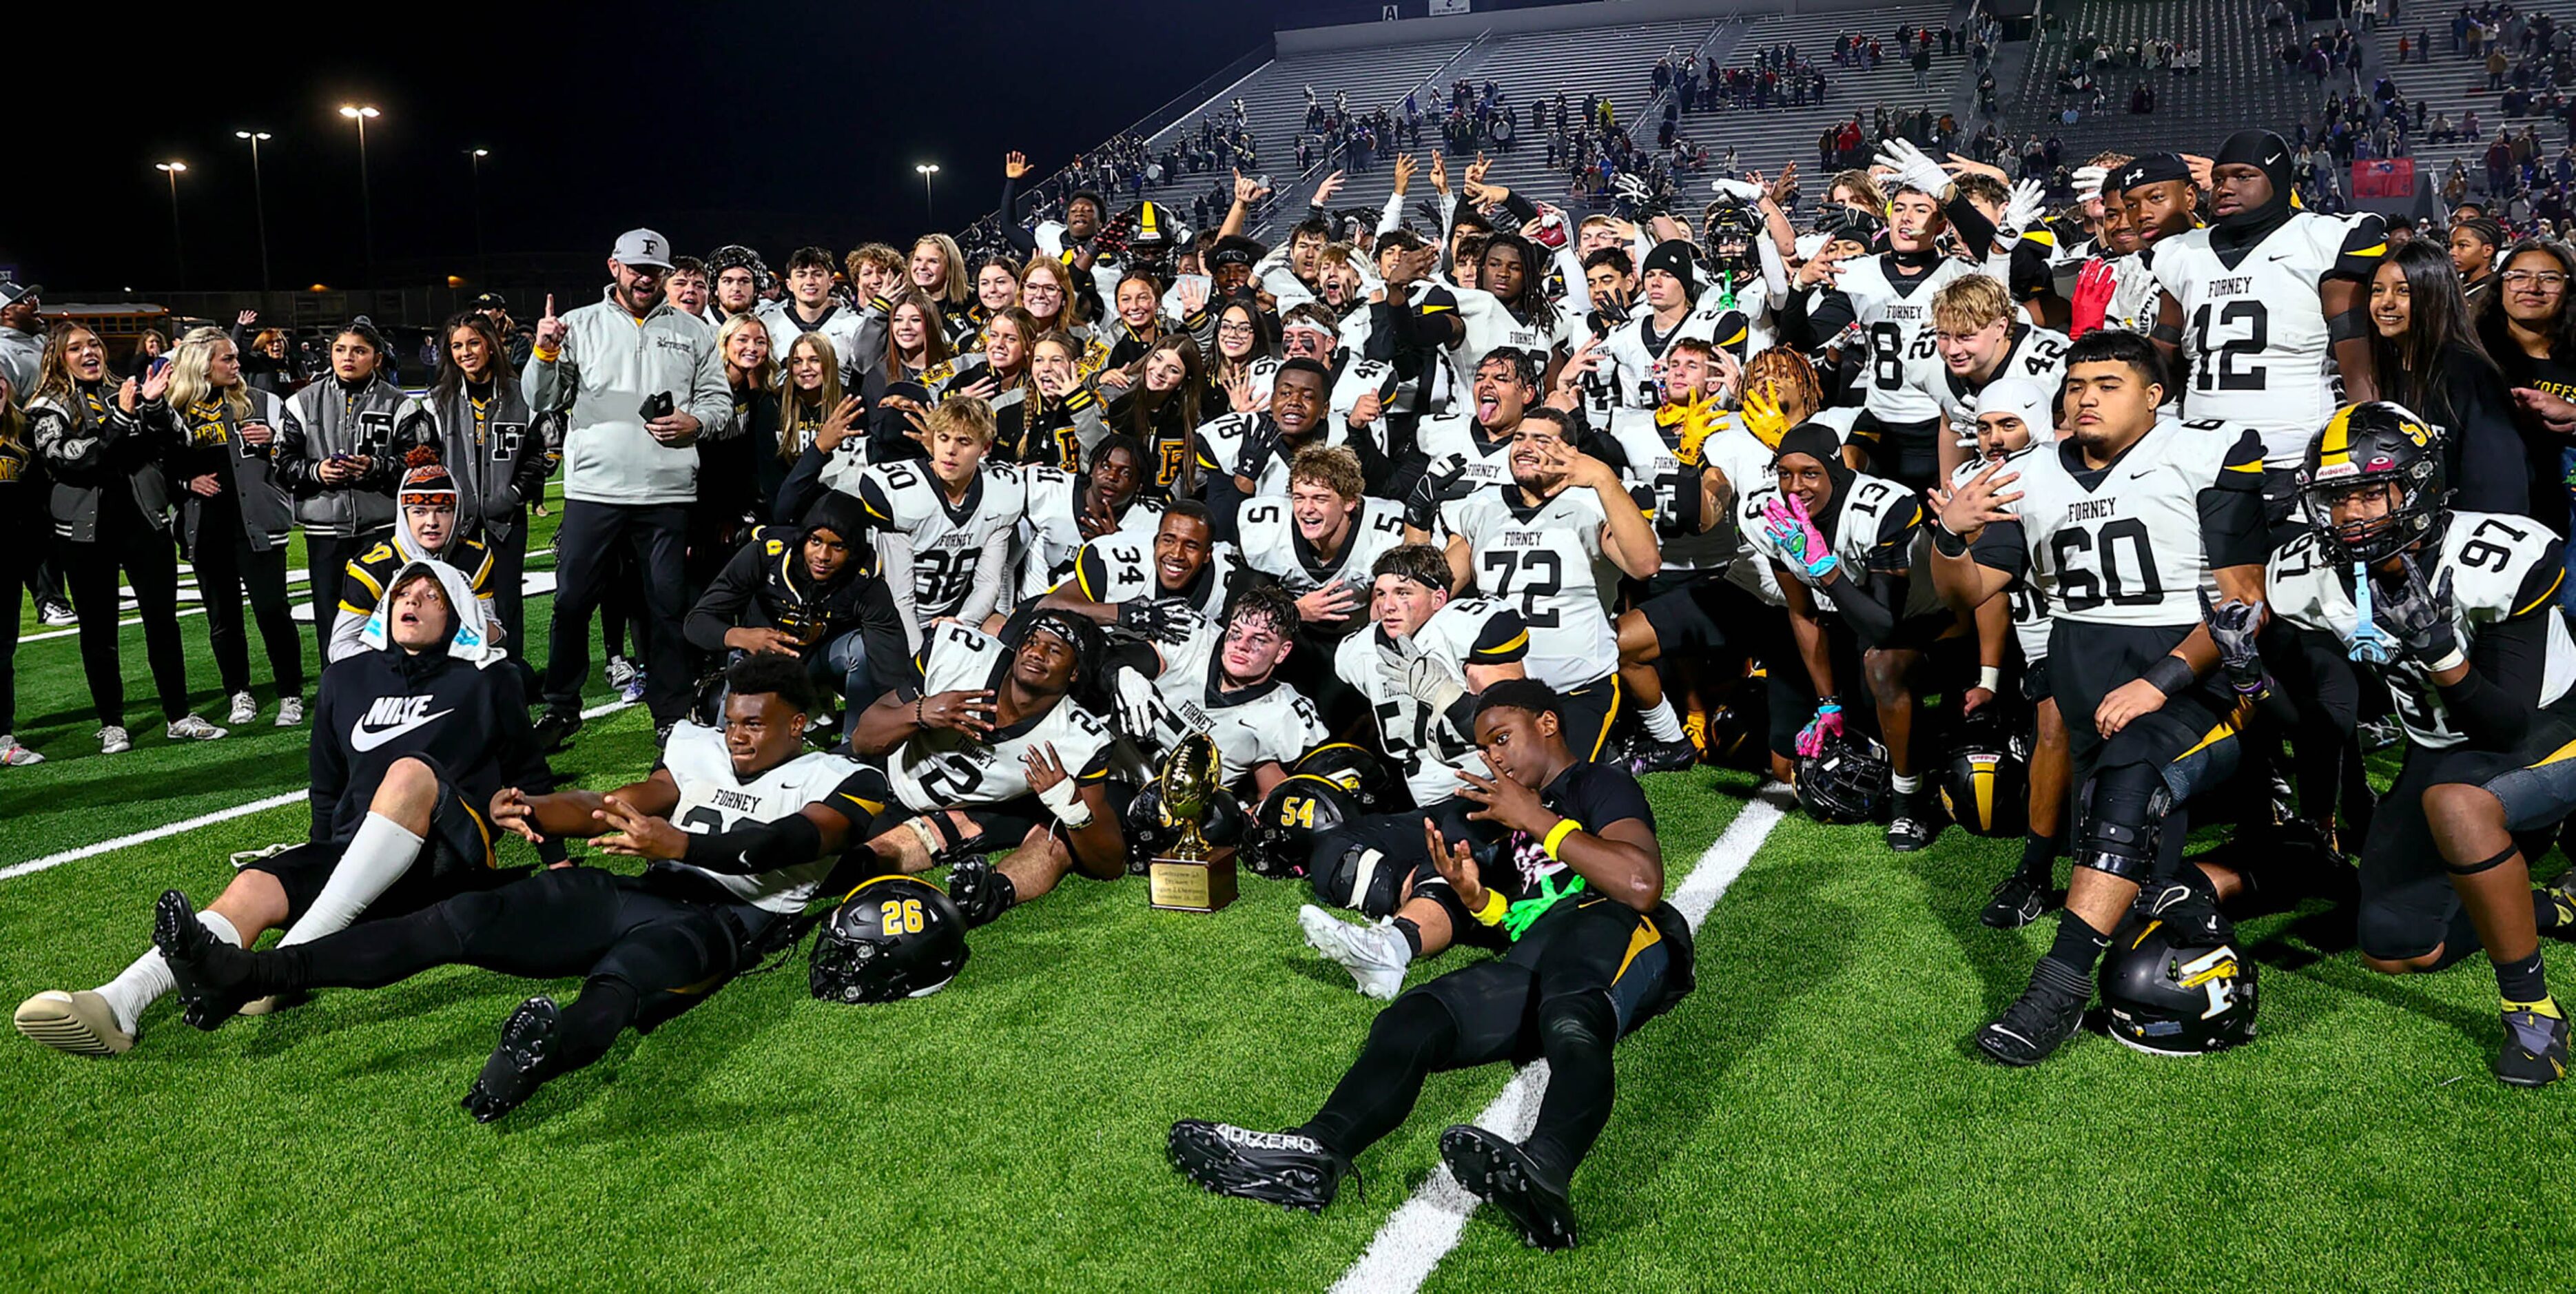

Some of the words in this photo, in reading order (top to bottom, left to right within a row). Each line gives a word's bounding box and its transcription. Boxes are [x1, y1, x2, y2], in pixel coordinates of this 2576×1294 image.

[1385, 6, 1396, 21] A
[642, 239, 659, 255] F
[2208, 276, 2252, 298] FORNEY
[1887, 305, 1922, 320] FORNEY
[1509, 331, 1537, 346] FORNEY
[2194, 300, 2267, 390] 12
[1871, 321, 1904, 391] 8
[2025, 340, 2068, 376] 42
[492, 422, 526, 460] F
[1215, 415, 1244, 439] 78
[1466, 464, 1501, 478] FORNEY
[1654, 456, 1680, 470] FORNE
[1248, 506, 1279, 523] 5
[1850, 483, 1890, 518] 13
[2068, 497, 2116, 522] FORNEY
[1374, 513, 1405, 537] 5
[1503, 531, 1543, 547] FORNEY
[939, 533, 974, 547] FORNEY
[2459, 518, 2528, 573] 97
[1112, 546, 1145, 585] 34
[2051, 517, 2164, 612] 60
[1484, 551, 1562, 628] 72
[949, 627, 986, 652] 2
[364, 694, 434, 727] NIKE
[1069, 709, 1103, 737] 2
[1179, 699, 1217, 734] FORNEY
[956, 737, 997, 770] FORNEY
[918, 754, 984, 807] 2
[711, 789, 762, 814] FORNEY
[1281, 796, 1316, 828] 54
[881, 899, 925, 936] 26
[1215, 1122, 1317, 1153] ADIZERO
